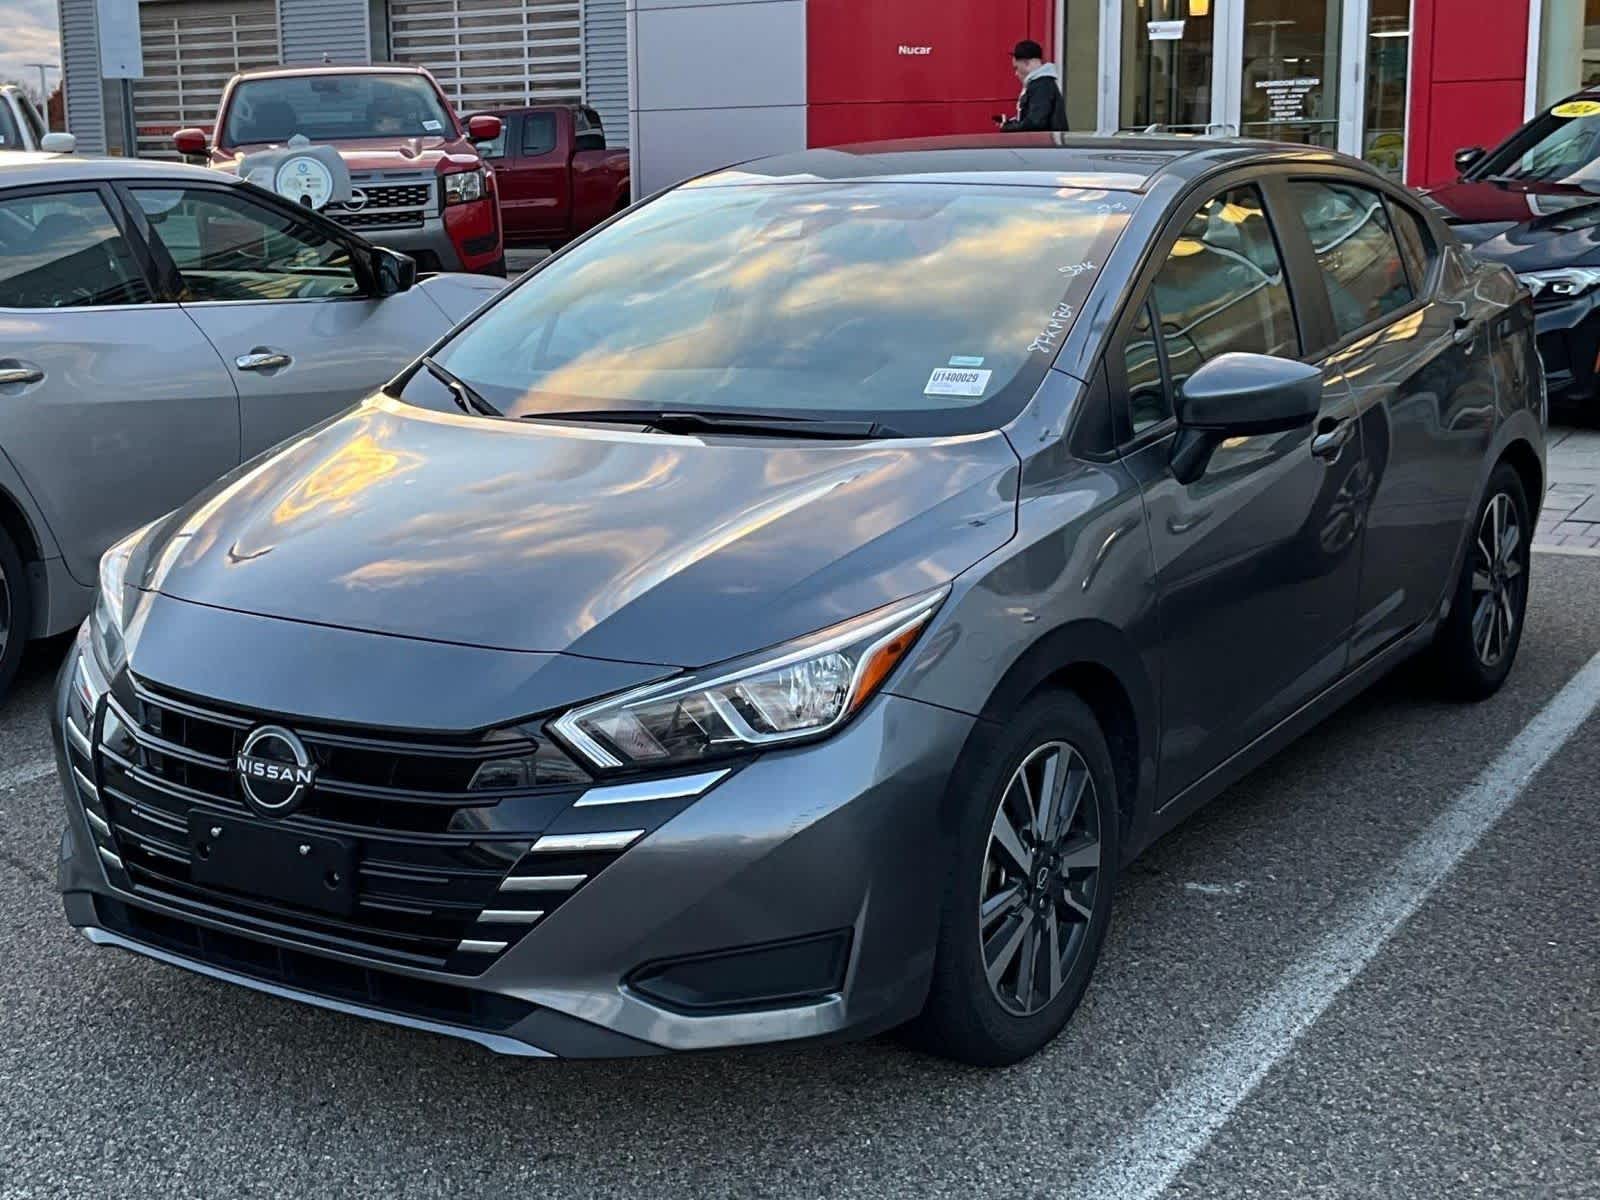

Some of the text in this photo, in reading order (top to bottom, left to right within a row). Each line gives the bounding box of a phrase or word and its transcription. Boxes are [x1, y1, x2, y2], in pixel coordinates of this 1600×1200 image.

[898, 45, 933, 55] Nucar
[1255, 78, 1320, 88] SHOWROOM HOURS
[932, 371, 980, 383] U1400029
[236, 757, 312, 784] NISSAN
